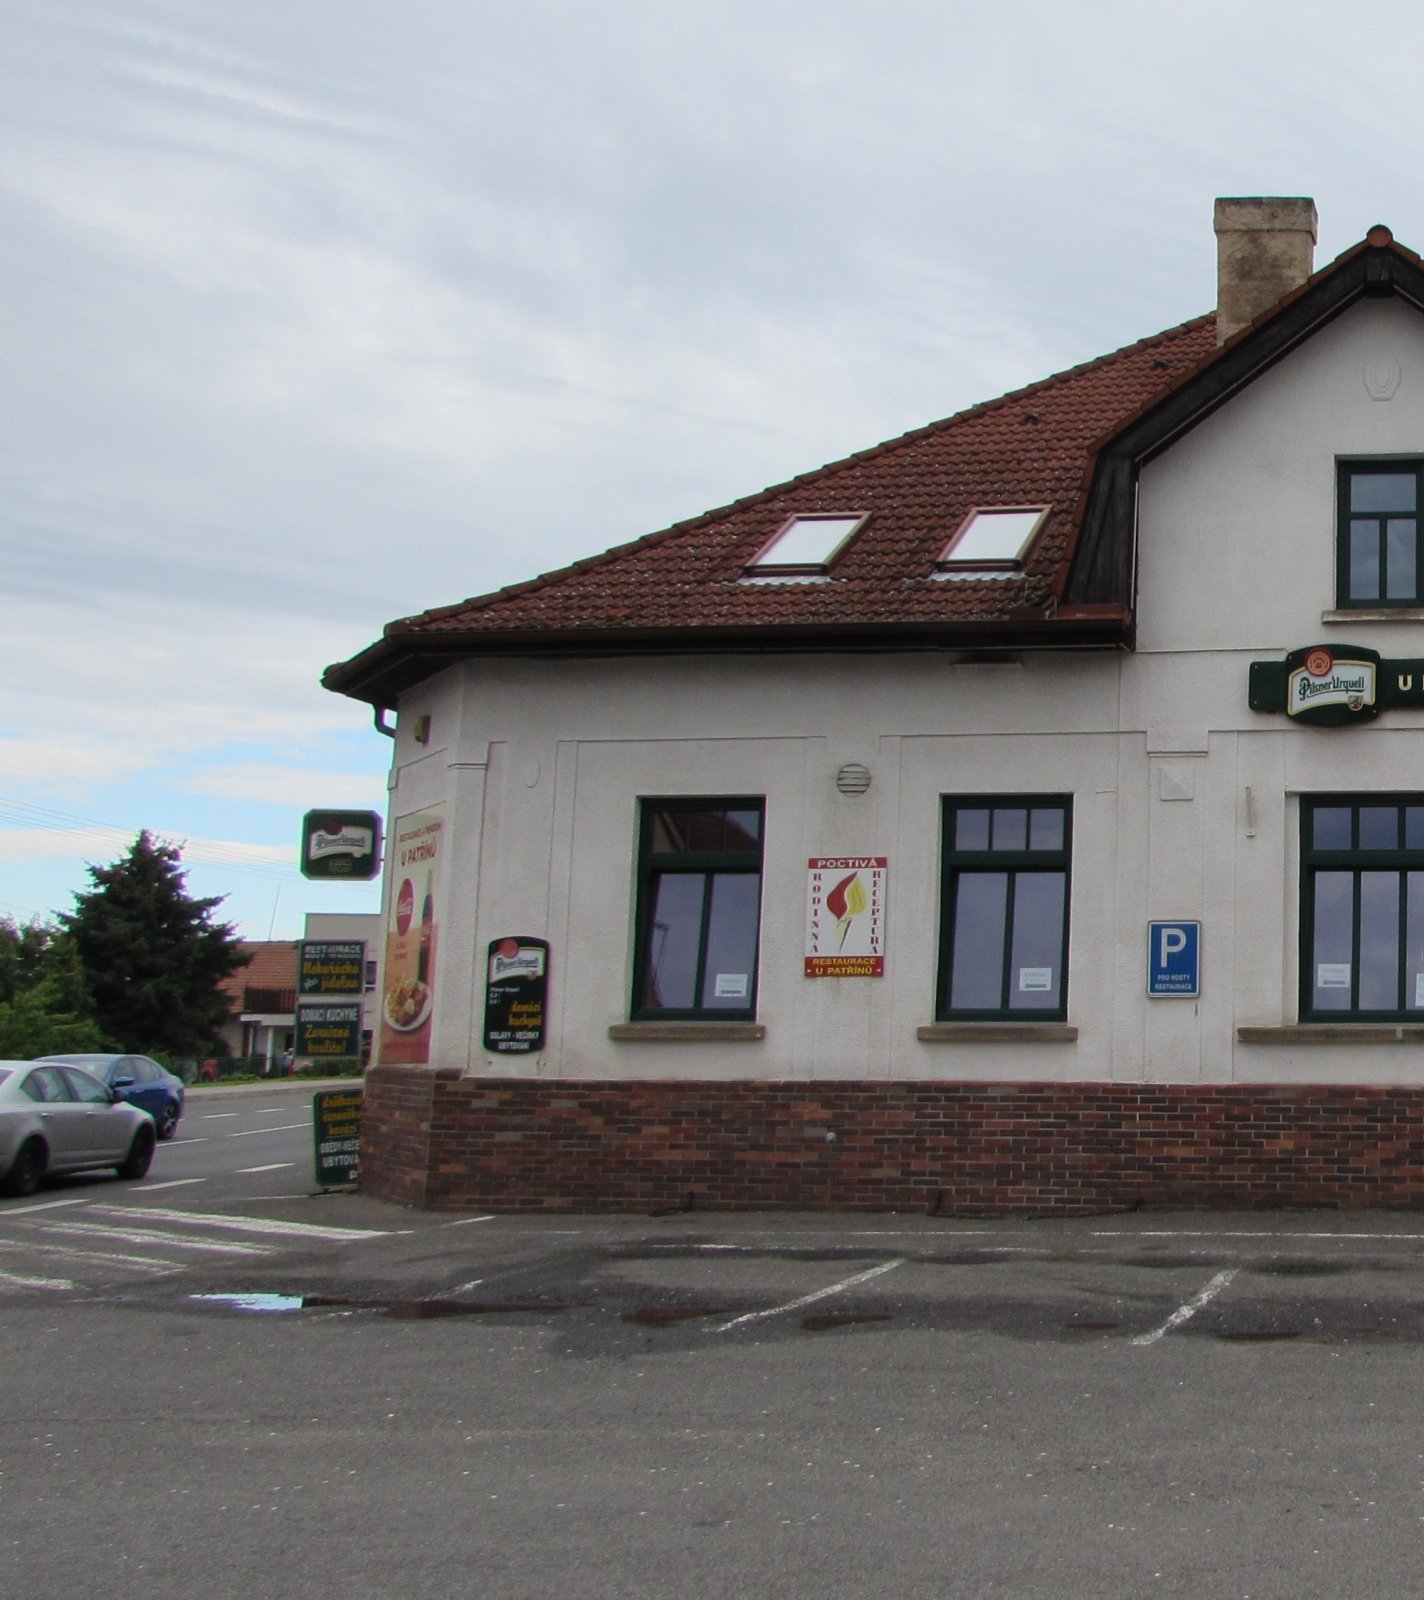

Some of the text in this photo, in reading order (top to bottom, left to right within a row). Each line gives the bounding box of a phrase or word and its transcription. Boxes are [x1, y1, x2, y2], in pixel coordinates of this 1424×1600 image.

[1299, 676, 1365, 701] Pilsner Urquell
[1398, 675, 1413, 691] U
[818, 858, 878, 868] POCTIVÁ
[811, 873, 822, 953] RODINNÁ
[870, 870, 881, 954] RECEPTURA
[1161, 928, 1187, 968] P
[828, 965, 872, 974] PATŘÍNŮ
